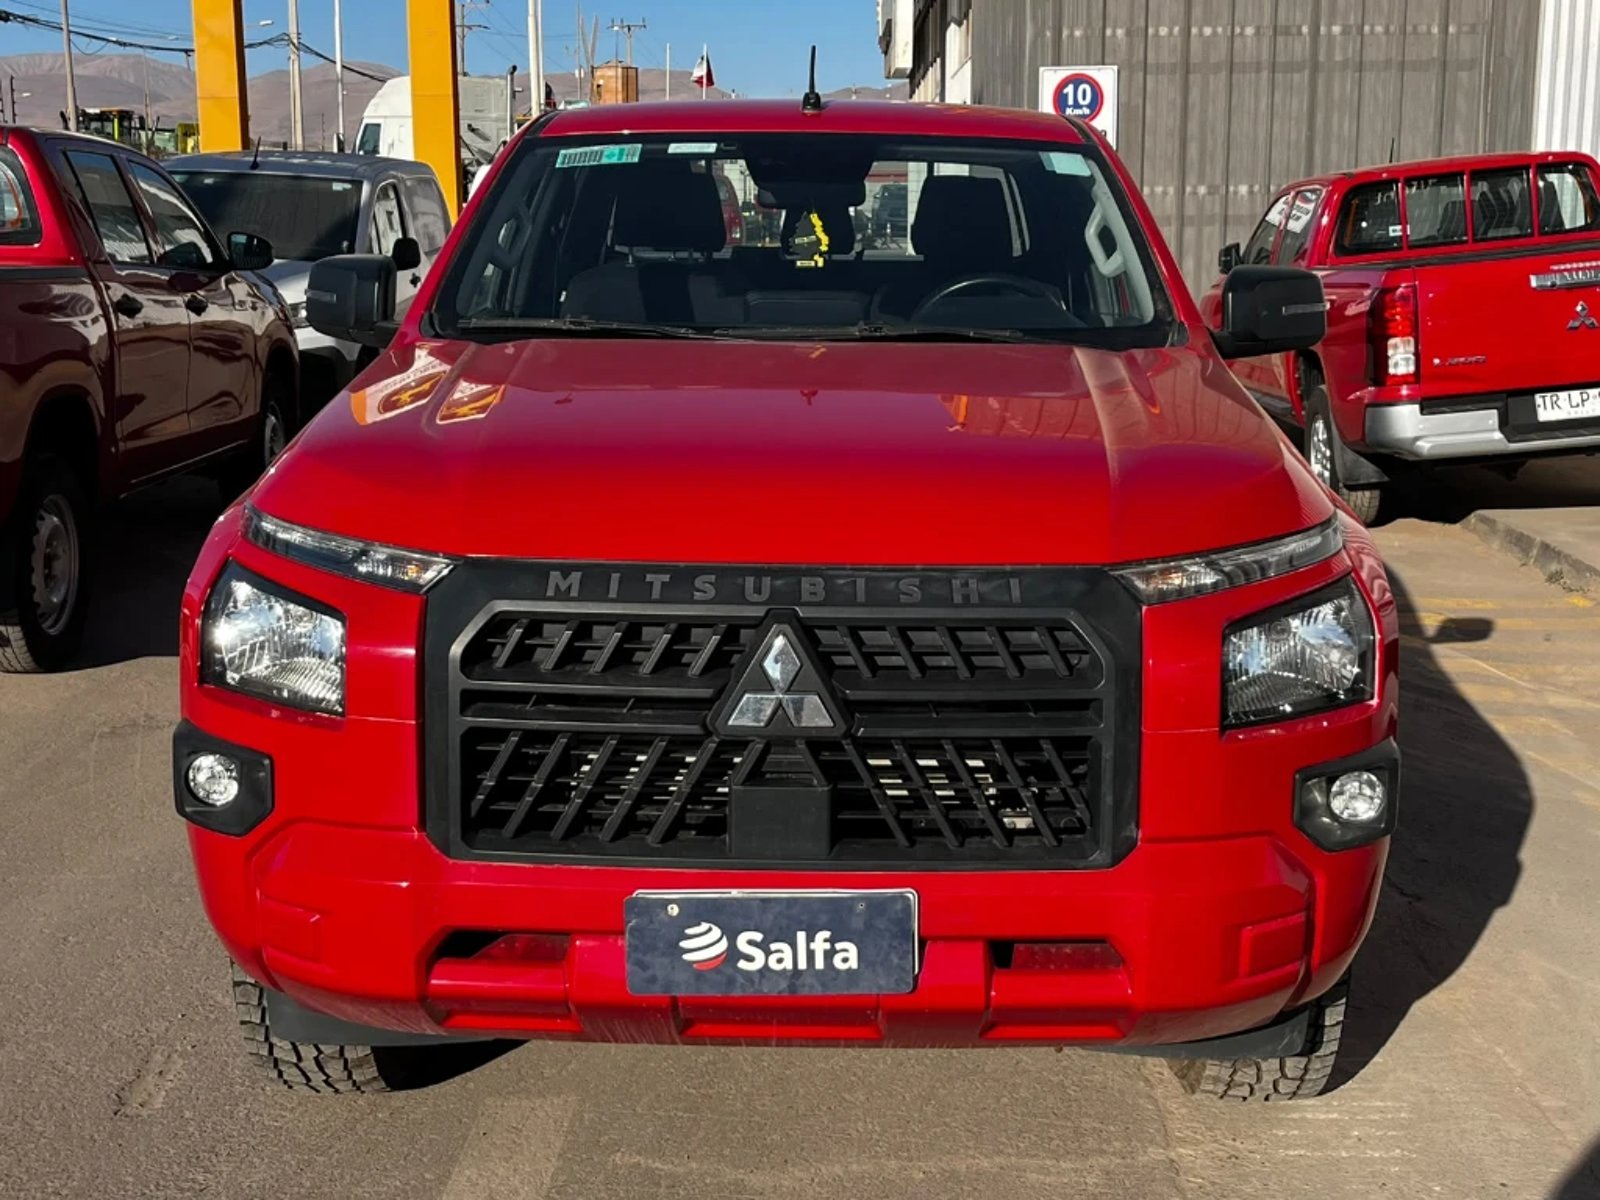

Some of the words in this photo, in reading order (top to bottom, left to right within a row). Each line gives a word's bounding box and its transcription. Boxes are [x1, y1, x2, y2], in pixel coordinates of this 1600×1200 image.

[1063, 83, 1092, 106] 10
[1538, 393, 1562, 411] TR
[1567, 391, 1590, 409] LP
[545, 571, 1022, 604] MITSUBISHI
[736, 930, 859, 972] Salfa
